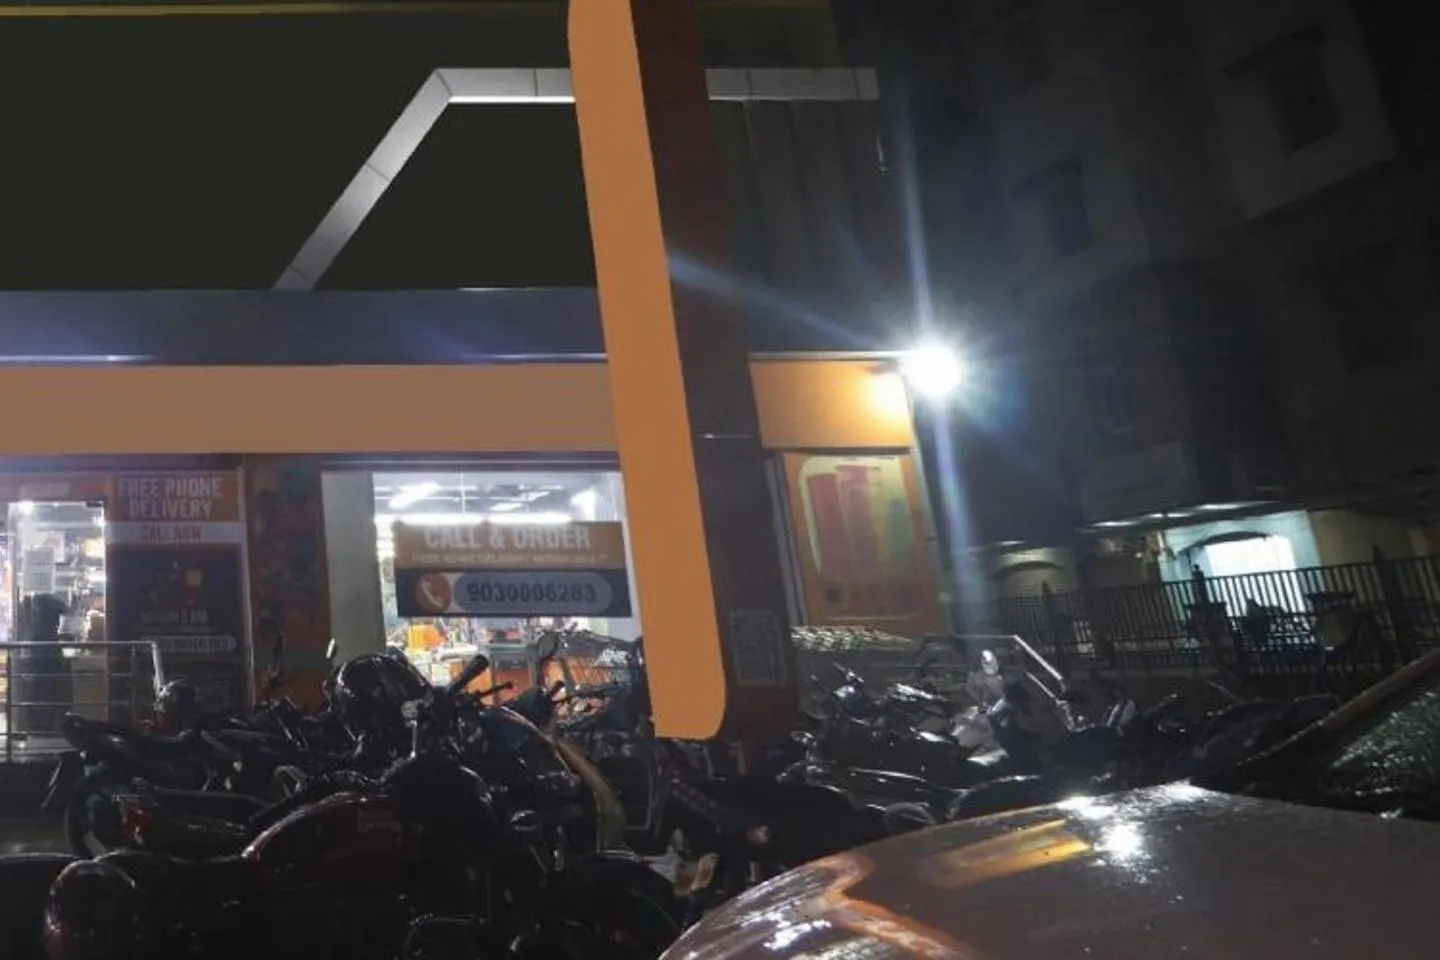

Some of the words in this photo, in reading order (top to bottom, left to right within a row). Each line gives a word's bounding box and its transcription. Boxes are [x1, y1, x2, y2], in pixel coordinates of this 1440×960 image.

[117, 477, 160, 498] FREE
[164, 476, 224, 498] PHONE
[128, 498, 212, 520] DELIVERY
[424, 525, 480, 549] CALL
[488, 526, 506, 549] &
[512, 525, 591, 550] ORDER
[465, 582, 597, 602] 9030006283
